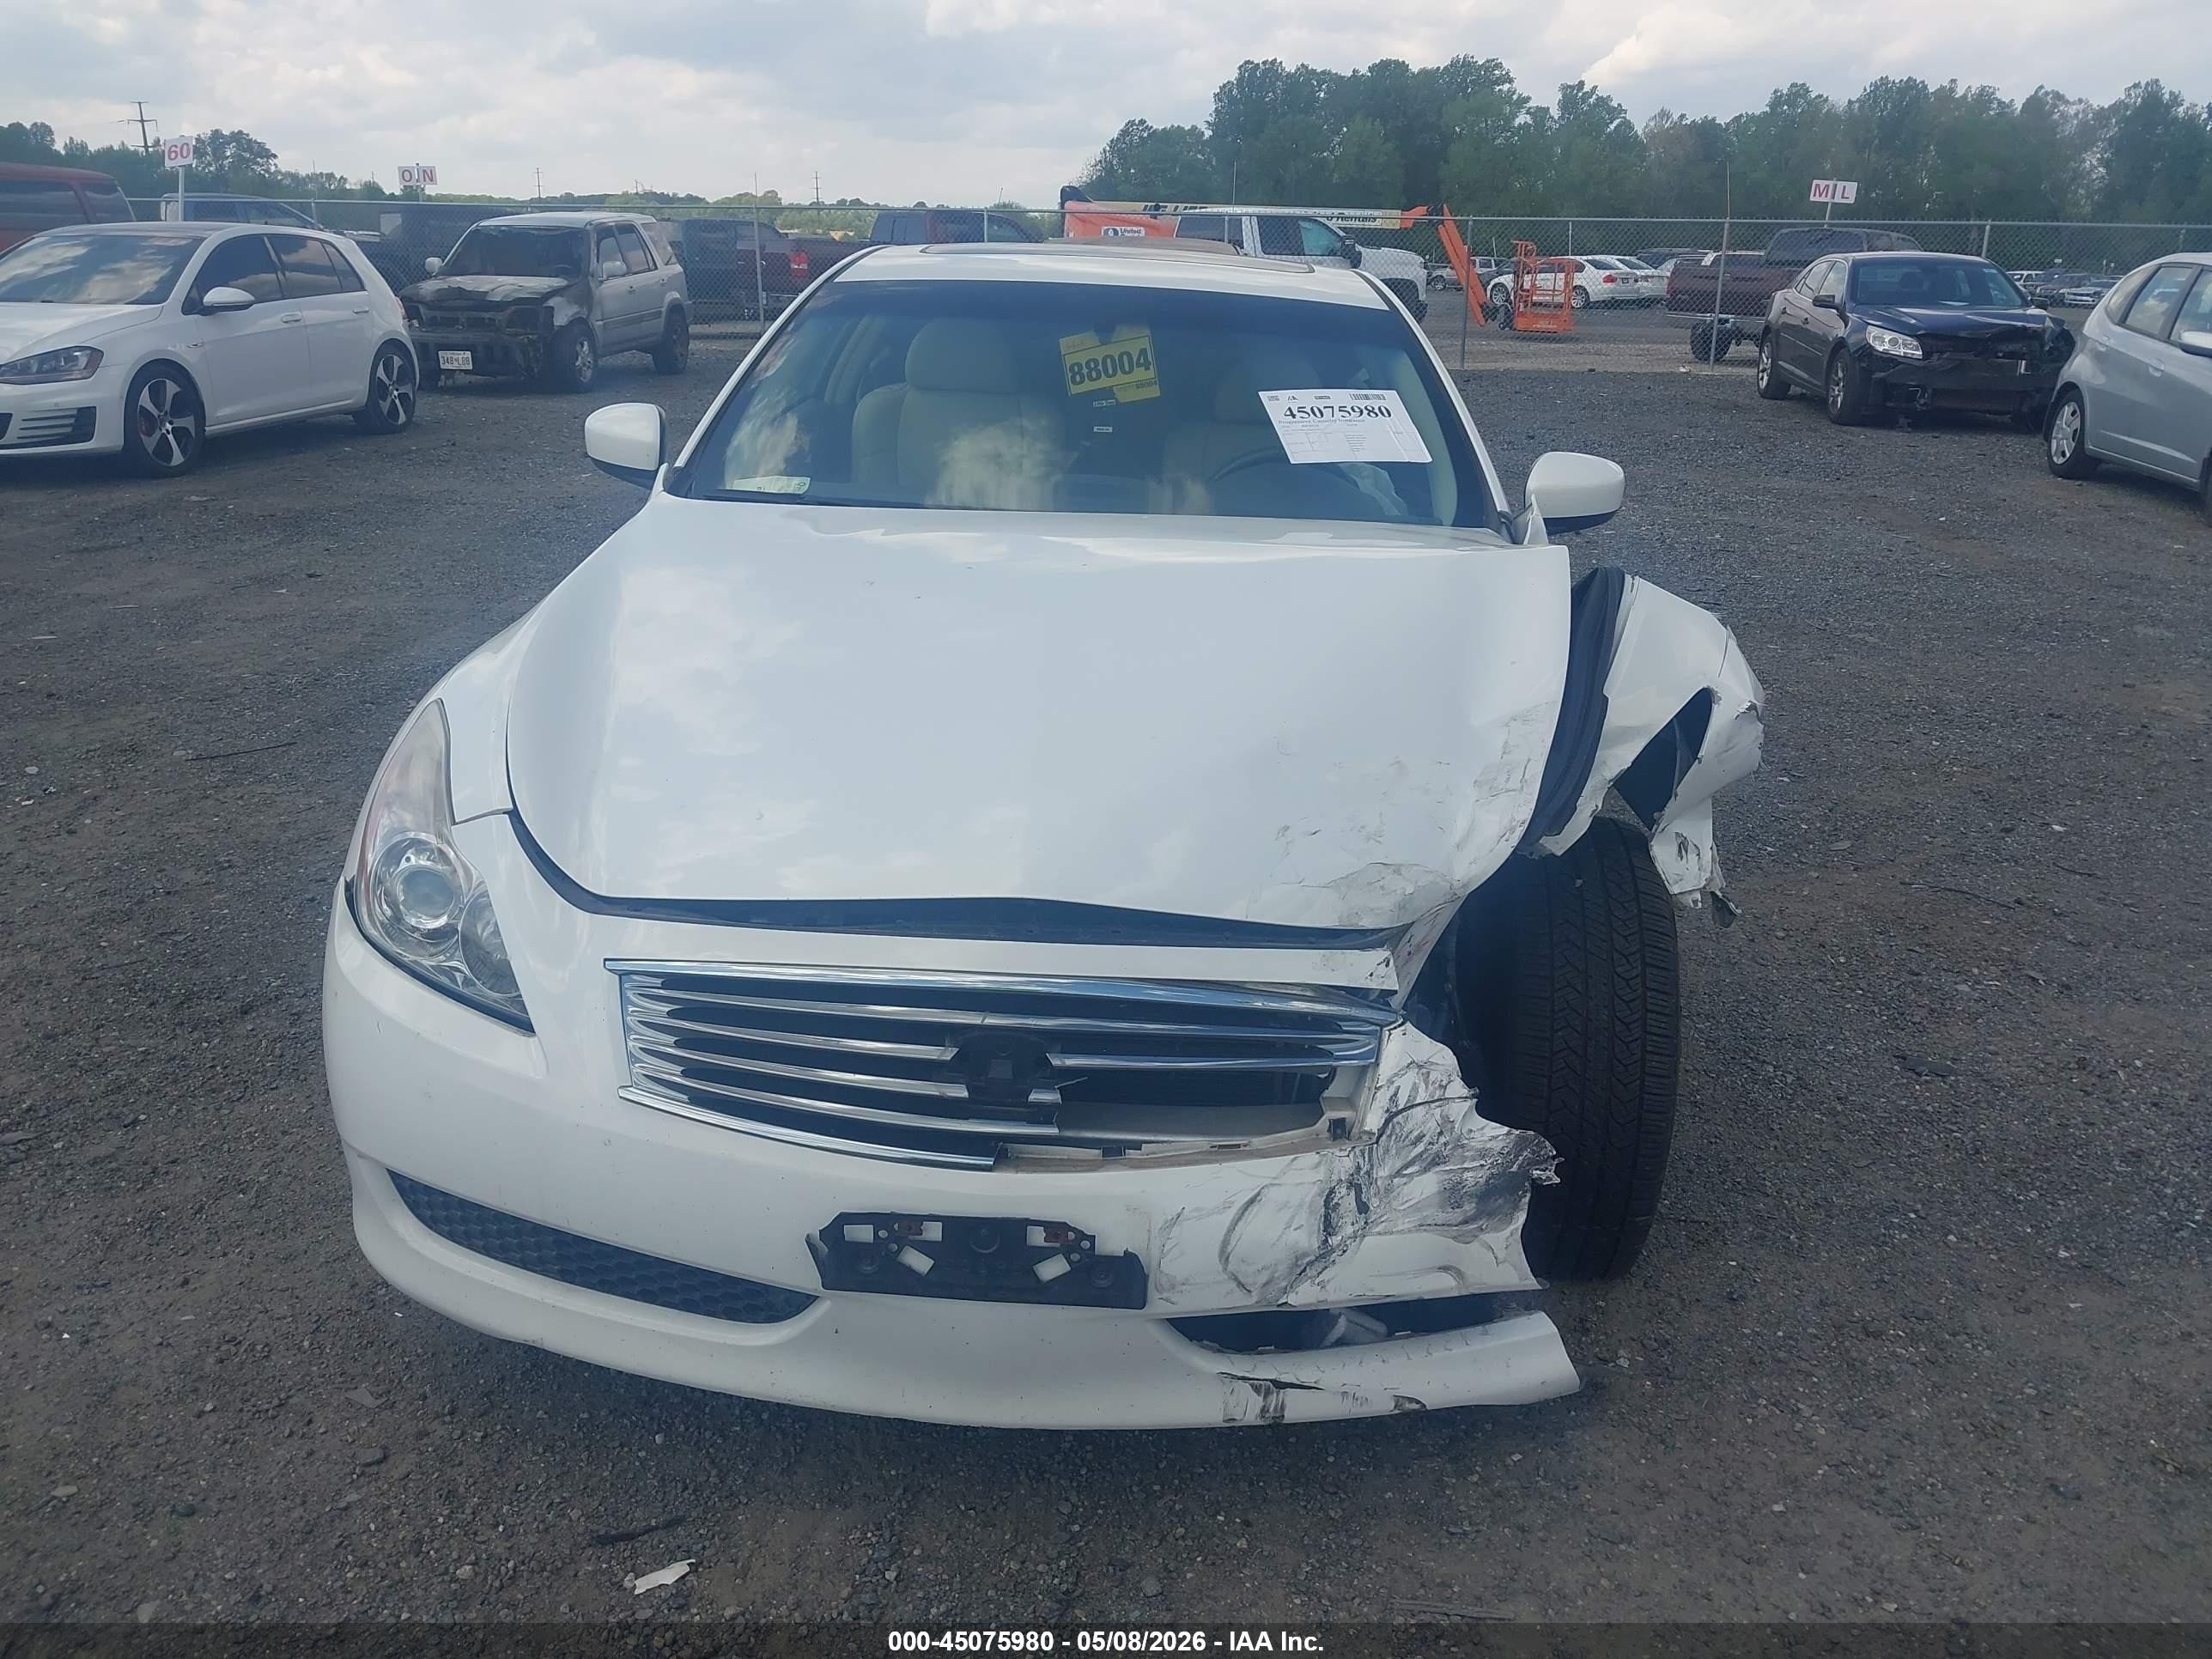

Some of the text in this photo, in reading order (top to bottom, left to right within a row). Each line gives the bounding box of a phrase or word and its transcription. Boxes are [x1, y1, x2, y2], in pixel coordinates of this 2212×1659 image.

[167, 143, 190, 161] 60
[1068, 347, 1152, 386] 88004
[1283, 404, 1392, 419] 45075980
